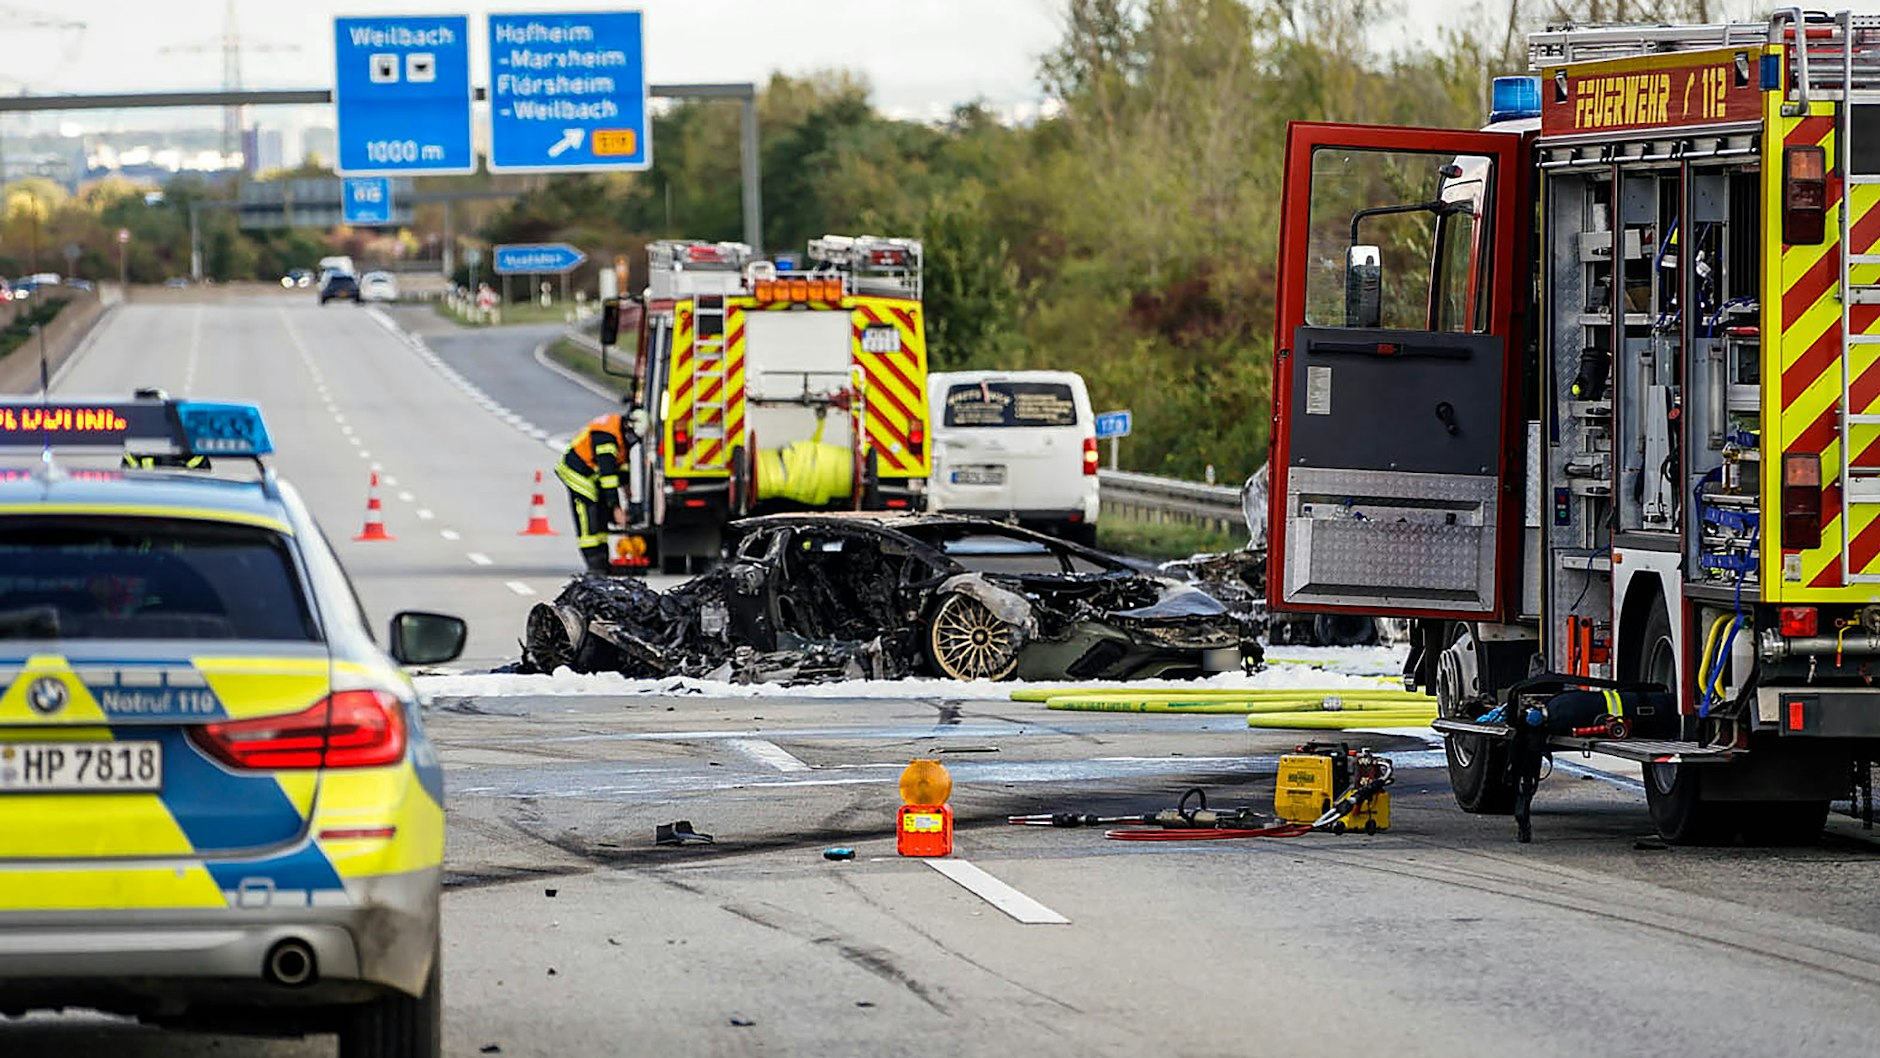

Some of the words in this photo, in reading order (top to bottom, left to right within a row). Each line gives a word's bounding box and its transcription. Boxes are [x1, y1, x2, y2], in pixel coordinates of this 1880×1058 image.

[349, 26, 455, 47] Weilbach
[496, 22, 594, 44] Hofheim
[1574, 73, 1671, 129] FEUERWEHR
[1702, 67, 1727, 119] 112
[367, 140, 419, 162] 1000
[421, 145, 445, 161] m
[102, 690, 172, 713] Notruf
[178, 691, 215, 713] 110
[24, 748, 65, 781] HP
[75, 748, 155, 781] 7818
